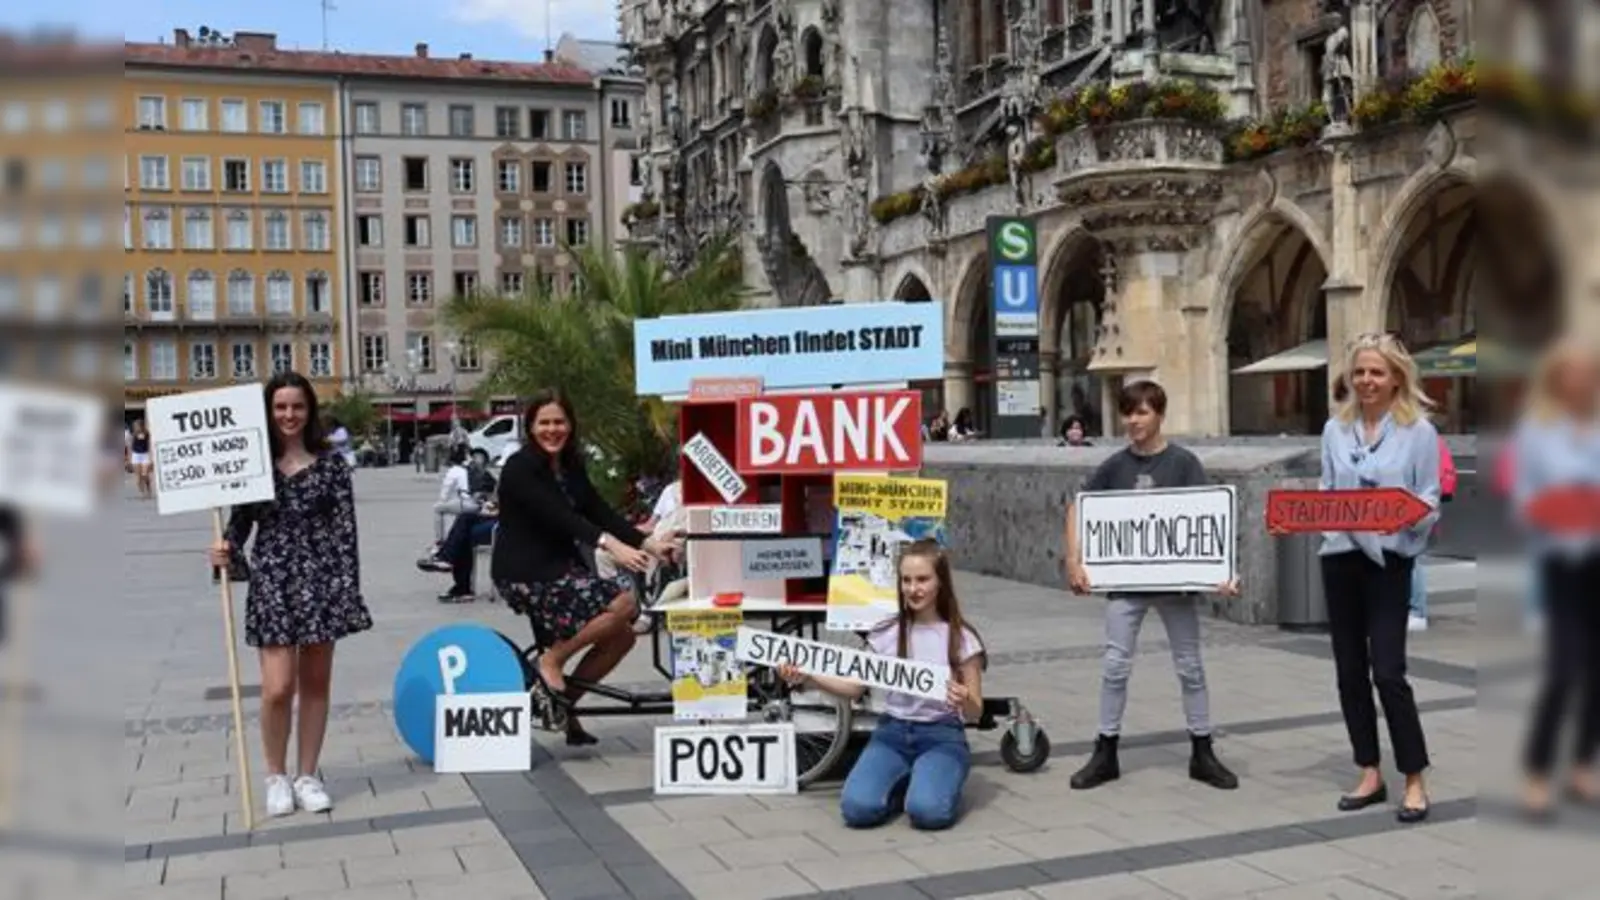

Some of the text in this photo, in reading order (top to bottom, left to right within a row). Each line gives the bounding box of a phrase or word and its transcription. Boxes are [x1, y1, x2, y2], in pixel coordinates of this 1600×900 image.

[1002, 221, 1029, 260] S
[1003, 269, 1028, 306] U
[651, 325, 923, 362] Mini München findet STADT
[172, 406, 237, 433] TOUR
[750, 396, 911, 466] BANK
[177, 442, 204, 458] OST
[212, 457, 249, 476] WEST
[689, 436, 743, 498] ARBEITEN
[1086, 512, 1226, 558] MINIMÜNCHEN
[438, 645, 468, 694] P
[748, 633, 935, 693] STADTPLANUNG
[444, 706, 524, 738] MARKT
[670, 734, 779, 783] POST
